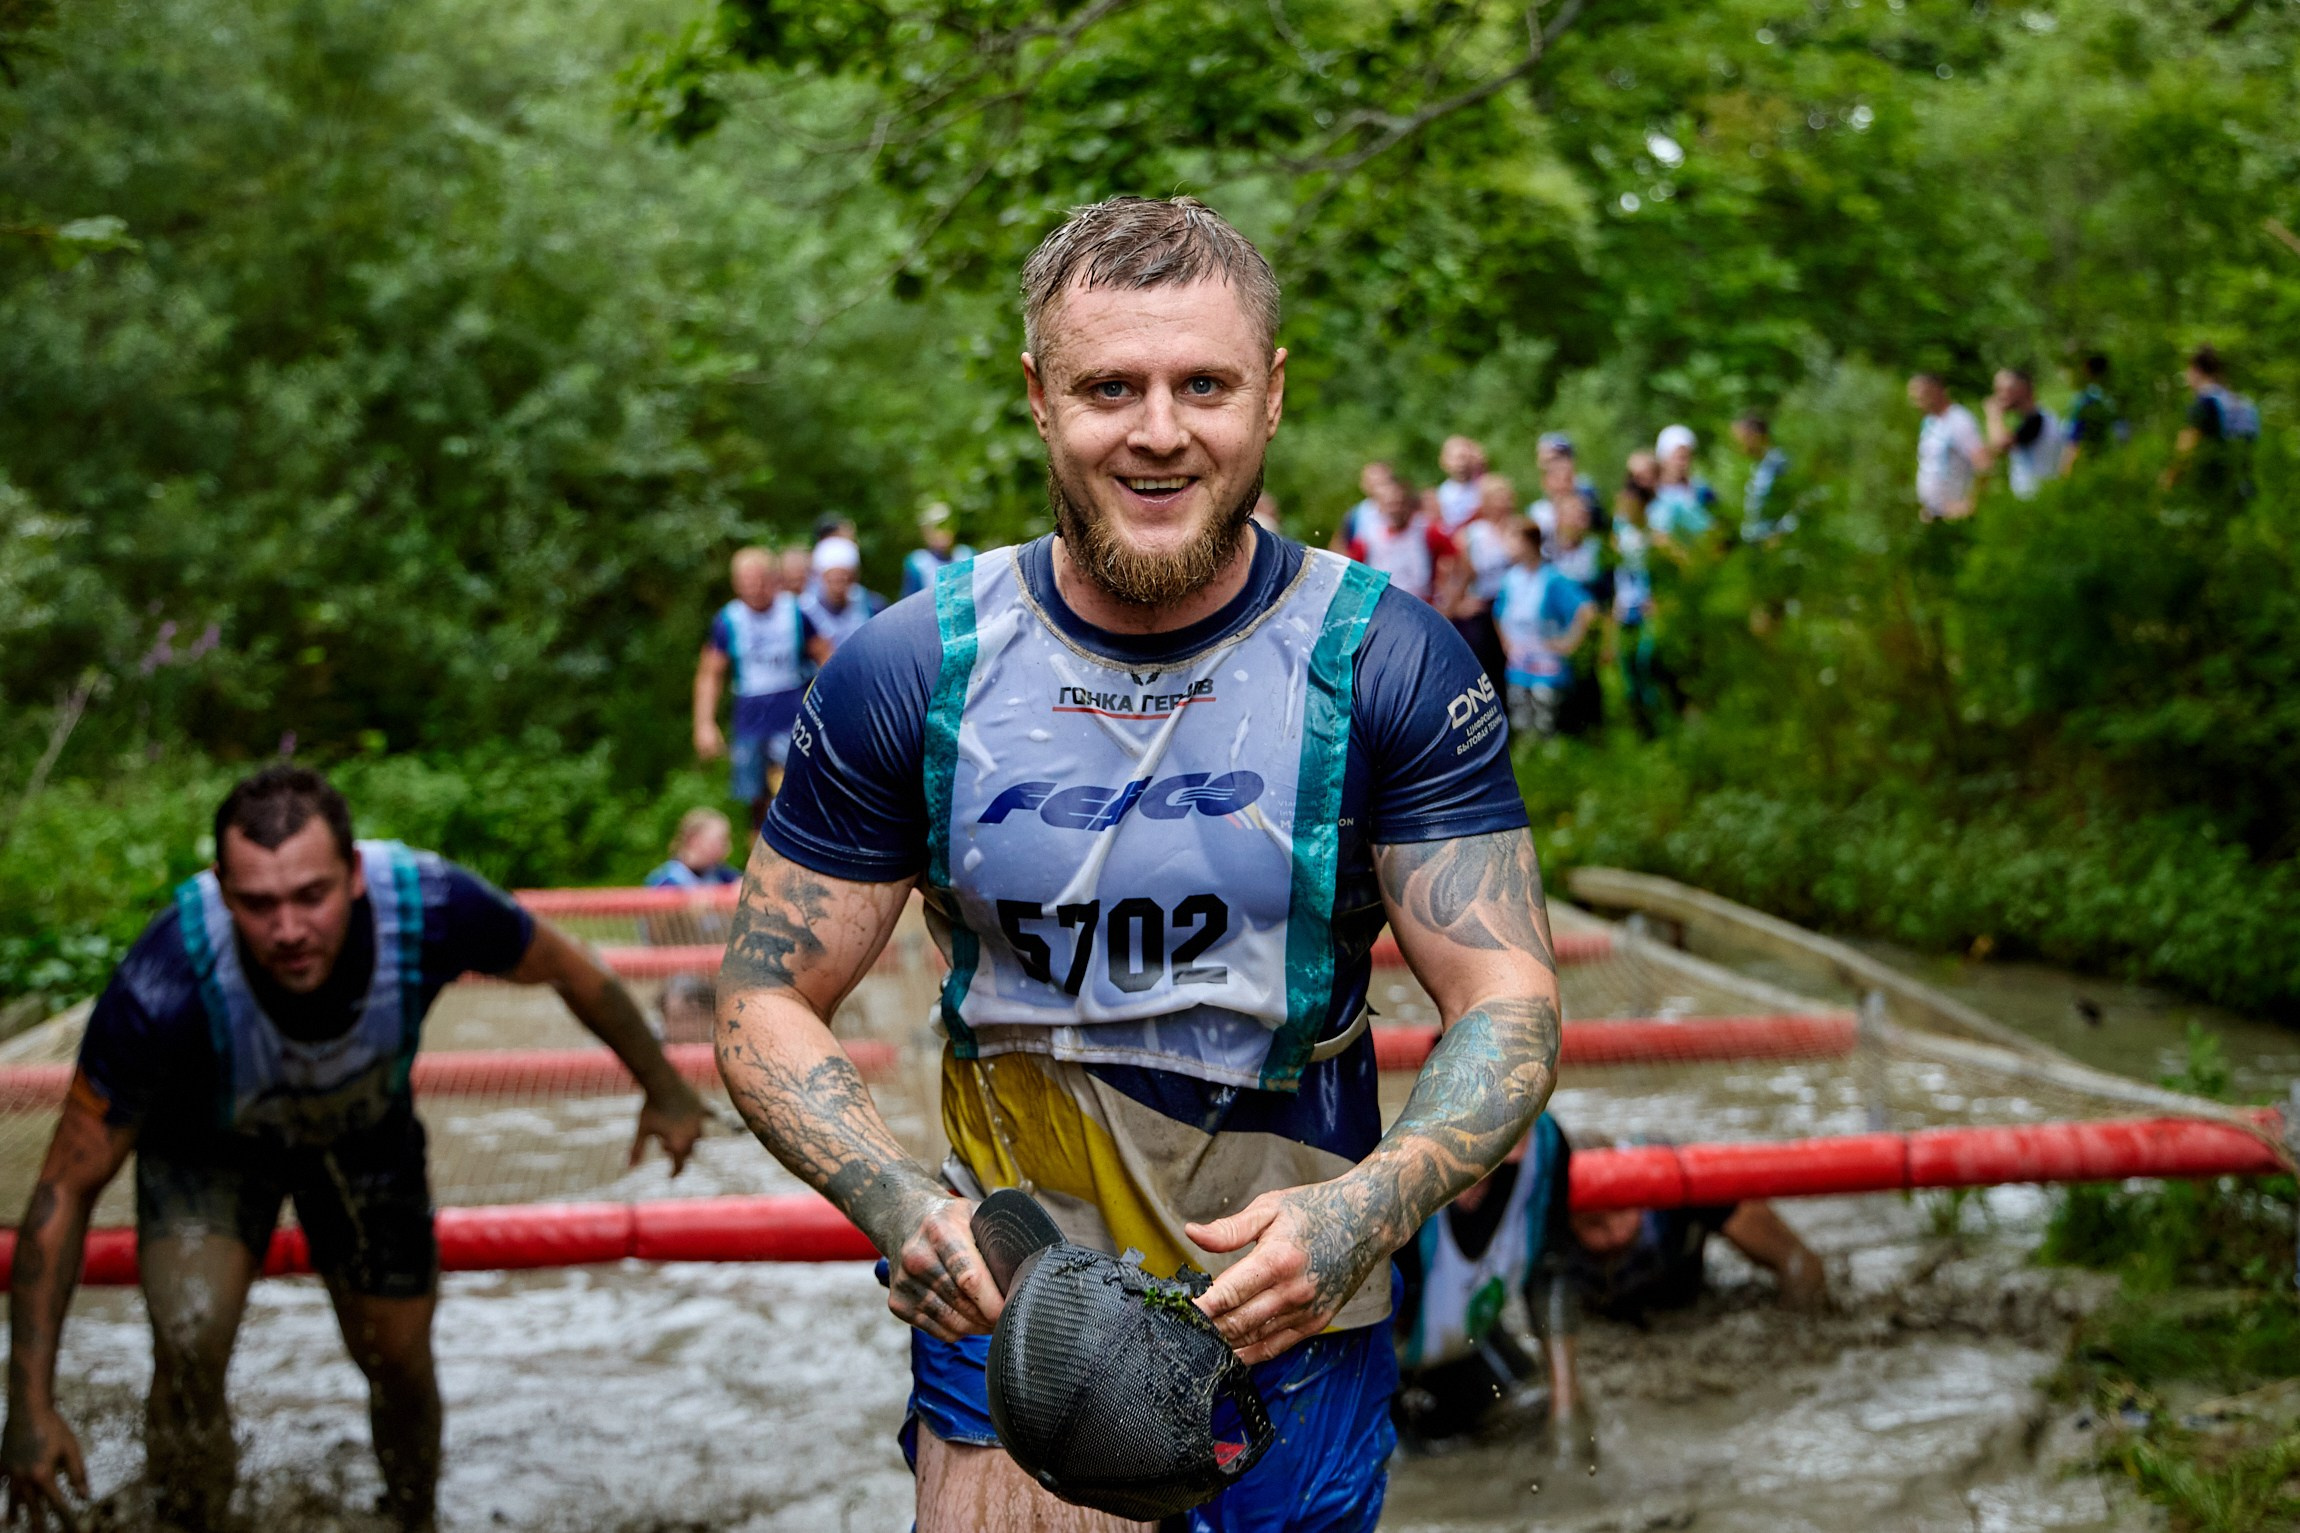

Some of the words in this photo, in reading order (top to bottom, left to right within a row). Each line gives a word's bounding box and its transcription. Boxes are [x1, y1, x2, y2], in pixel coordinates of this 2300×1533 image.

[1059, 687, 1133, 712] ГОНКА
[1447, 673, 1495, 729] DNS
[996, 893, 1228, 996] 5702
